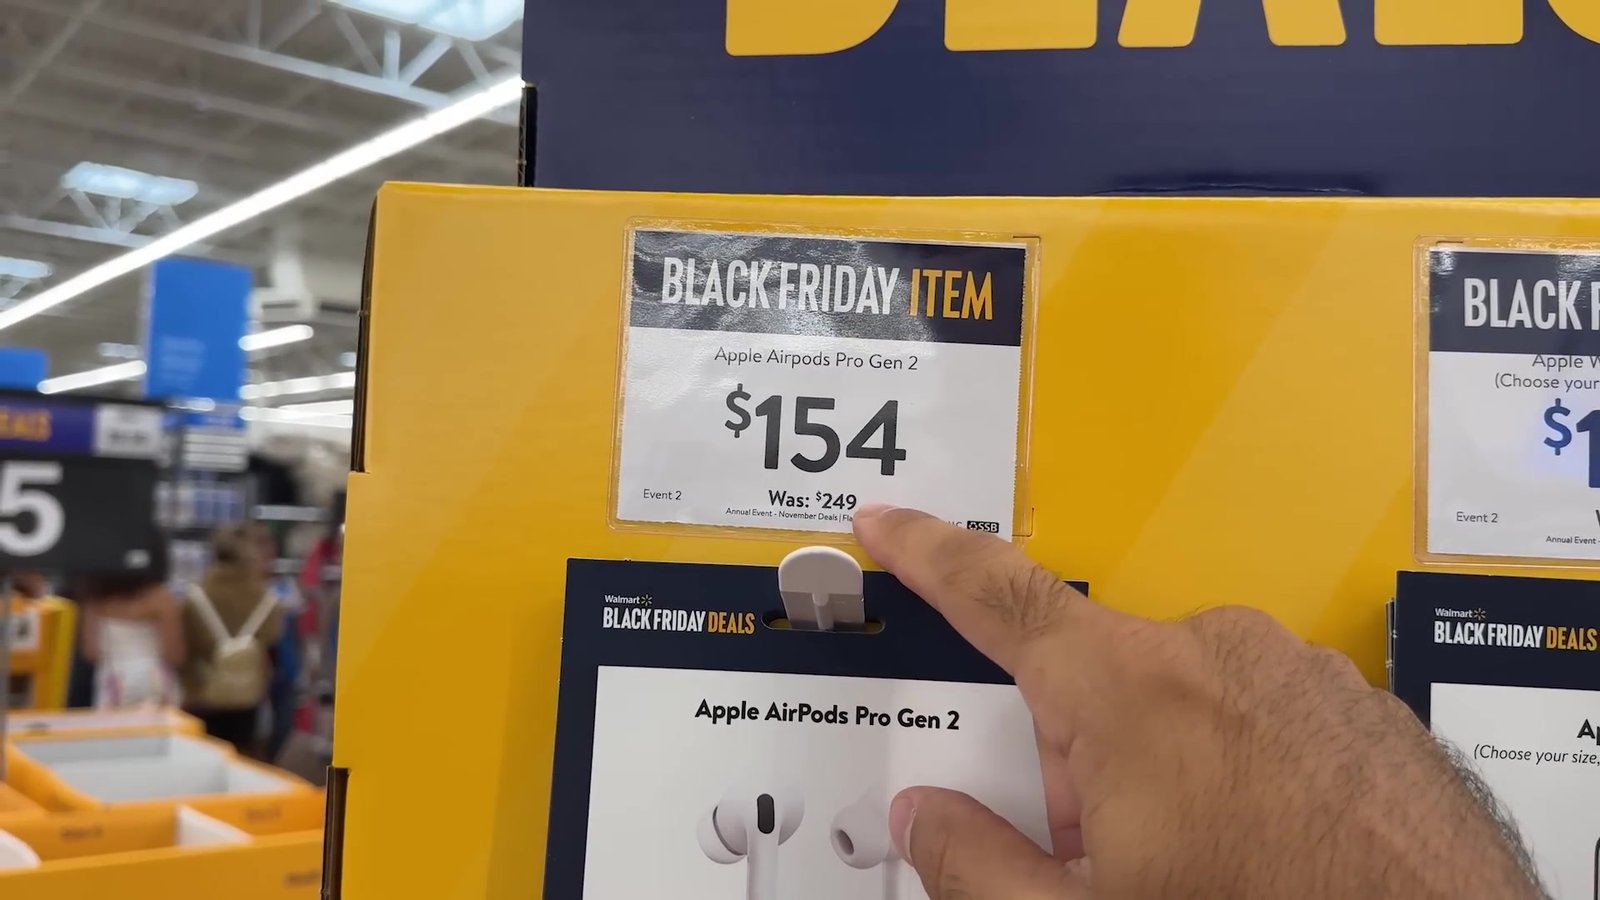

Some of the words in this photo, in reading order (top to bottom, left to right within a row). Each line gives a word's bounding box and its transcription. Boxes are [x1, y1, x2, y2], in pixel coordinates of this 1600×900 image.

[661, 256, 772, 309] BLACK
[778, 262, 901, 316] FRIDAY
[909, 268, 994, 320] ITEM
[1463, 278, 1583, 330] BLACK
[714, 346, 762, 365] Apple
[767, 348, 830, 369] Airpods
[836, 351, 864, 368] Pro
[868, 353, 904, 370] Gen
[908, 356, 918, 371] 2
[1532, 354, 1584, 372] Apple
[1495, 372, 1560, 389] (Choose
[724, 383, 907, 476] $154
[643, 489, 672, 500] Event
[674, 490, 683, 501] 2
[768, 489, 810, 508] Was:
[815, 490, 857, 510] $249
[726, 507, 751, 516] Annual
[752, 508, 772, 517] Event
[778, 511, 816, 520] November
[818, 513, 838, 521] Deals
[1456, 511, 1488, 523] Event
[1491, 512, 1498, 523] 2
[1545, 535, 1573, 544] Annual
[1574, 536, 1596, 545] Event
[604, 594, 640, 604] Walmart
[602, 606, 652, 630] BLACK
[653, 608, 706, 632] FRIDAY
[707, 611, 756, 635] DEALS
[1434, 608, 1473, 618] Walmart
[1434, 621, 1486, 646] BLACK
[1487, 623, 1544, 648] FRIDAY
[1546, 626, 1598, 651] DEALS
[694, 698, 759, 725] Apple
[764, 701, 848, 725] AirPods
[855, 705, 891, 727] Pro
[897, 708, 940, 729] Gen
[947, 710, 960, 730] 2
[1474, 744, 1532, 761] (Choose
[1536, 751, 1569, 765] your
[1571, 749, 1600, 766] size,
